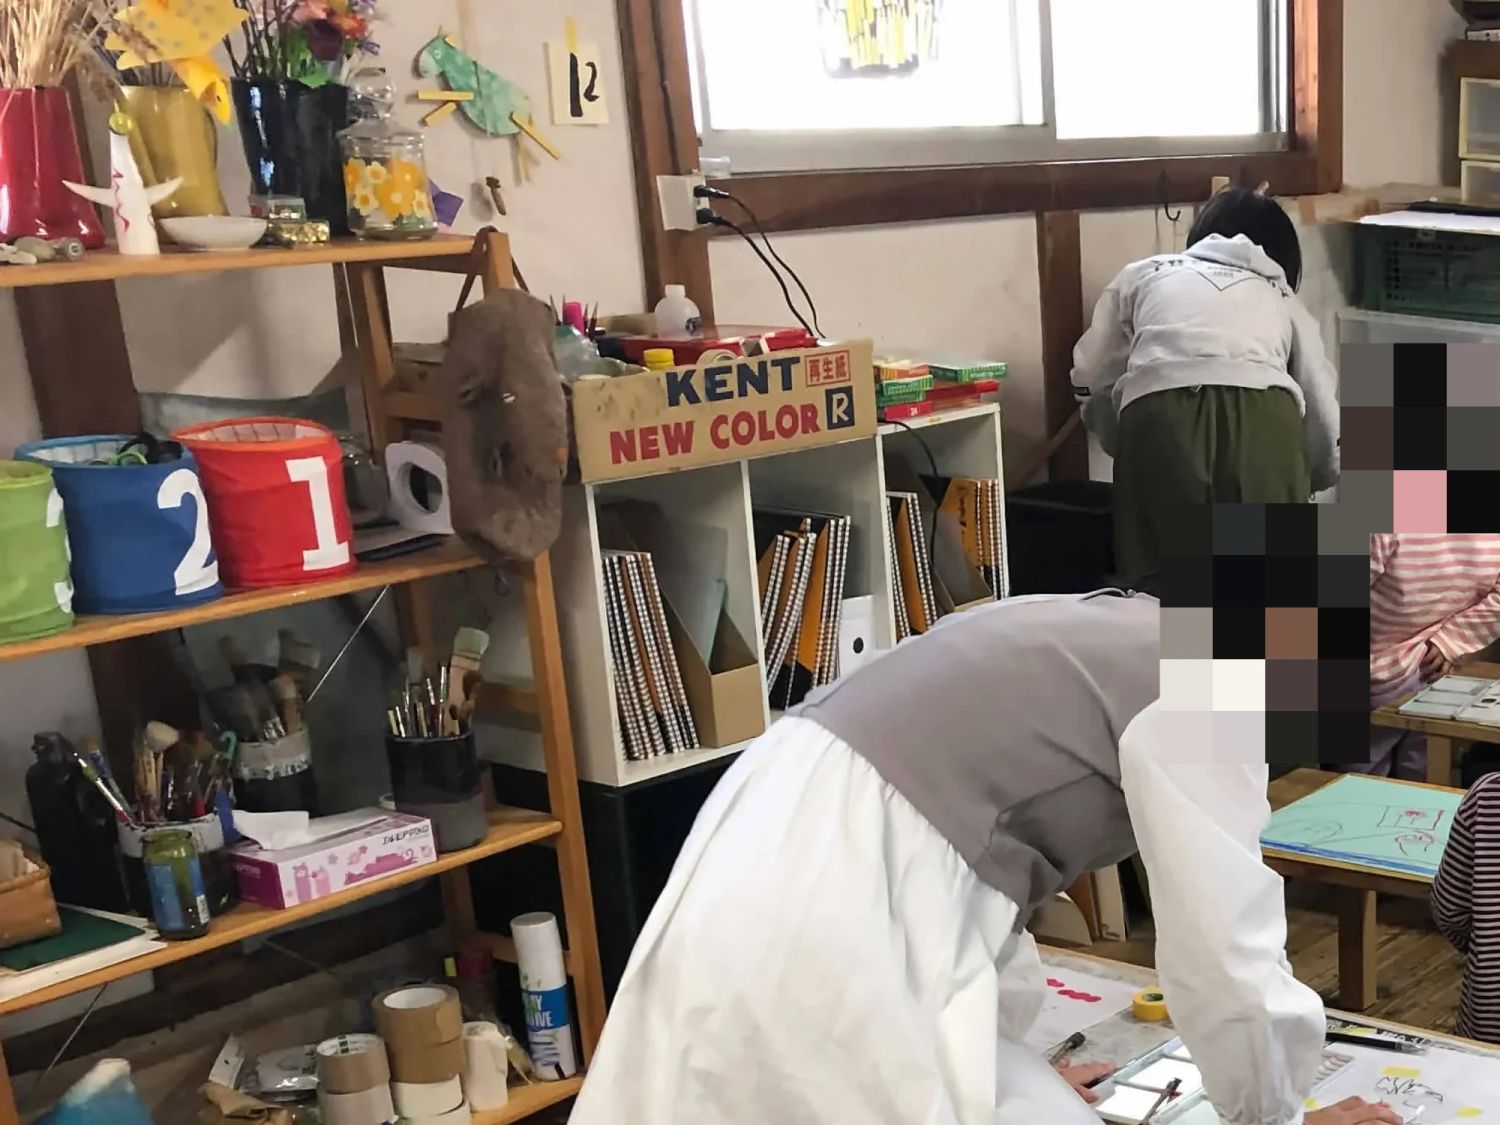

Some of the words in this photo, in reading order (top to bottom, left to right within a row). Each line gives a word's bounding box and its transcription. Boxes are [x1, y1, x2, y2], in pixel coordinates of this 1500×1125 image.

[569, 52, 600, 117] 12
[665, 356, 800, 408] KENT
[808, 354, 848, 383] 再生紙
[610, 420, 695, 465] NEW
[710, 403, 821, 450] COLOR
[831, 392, 849, 424] R
[157, 468, 219, 595] 2
[285, 456, 350, 571] 1
